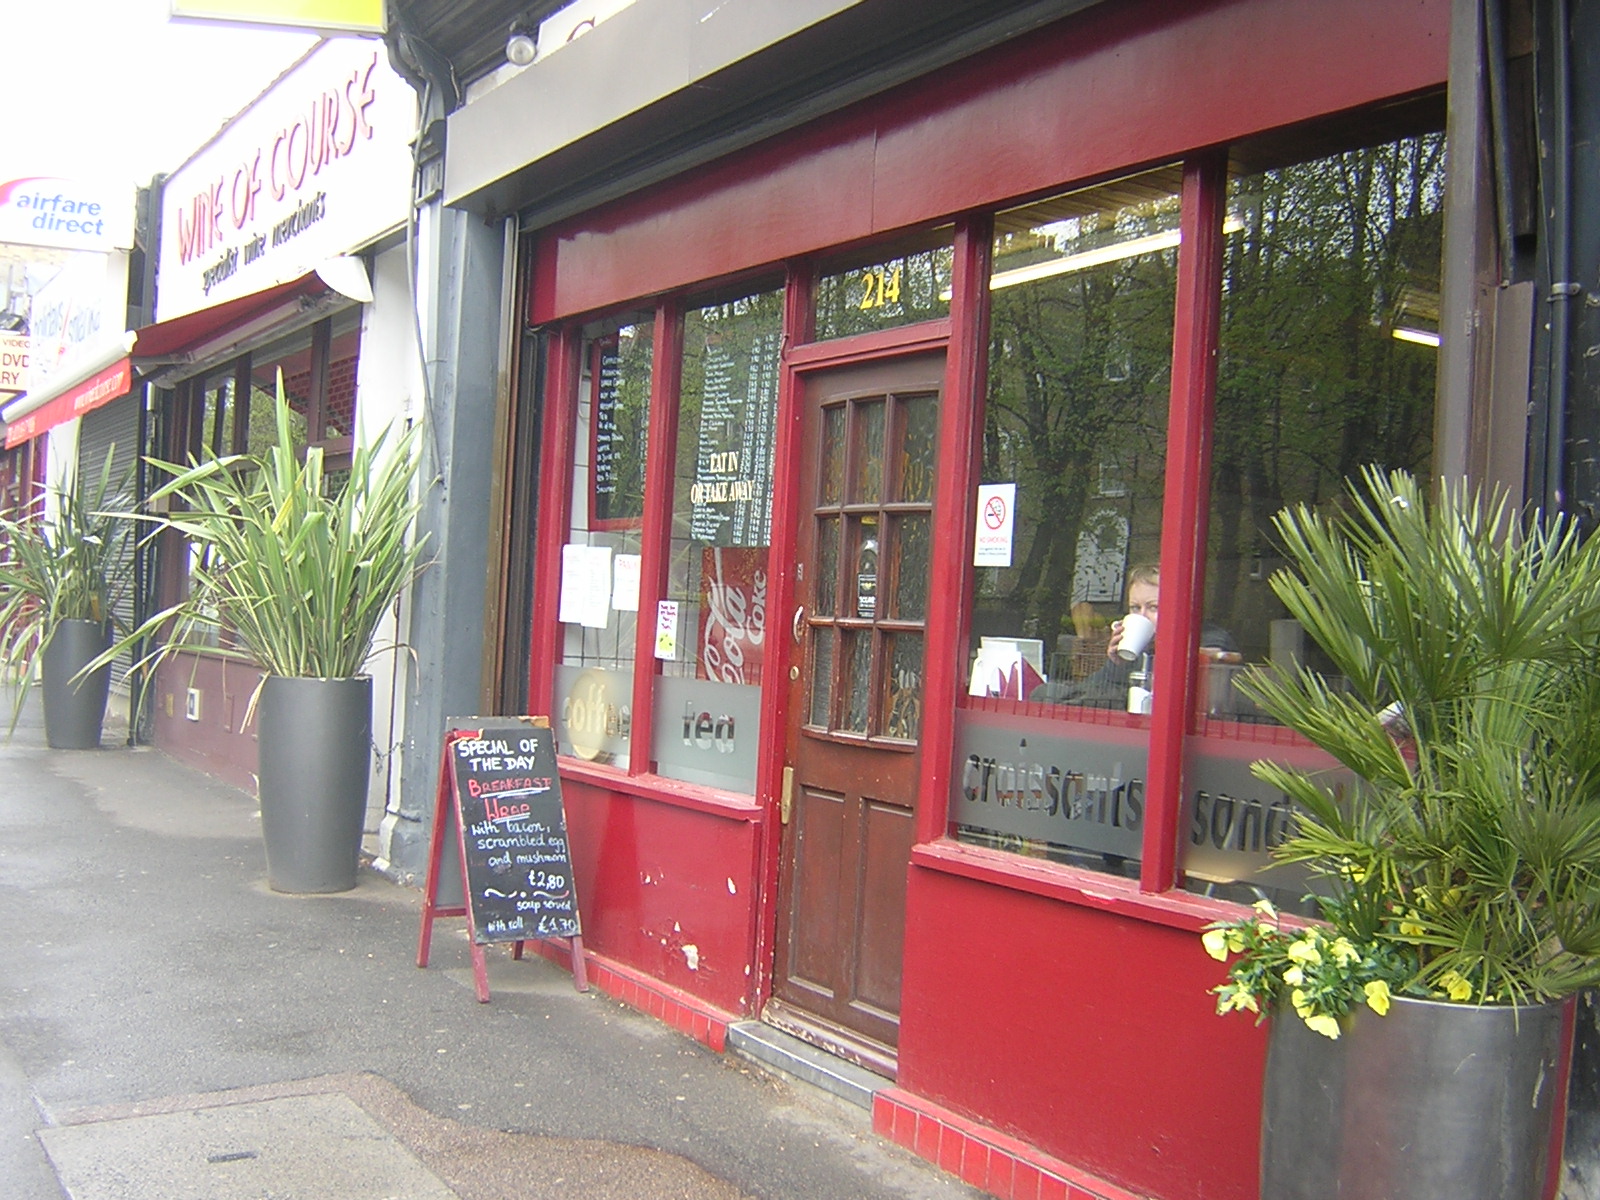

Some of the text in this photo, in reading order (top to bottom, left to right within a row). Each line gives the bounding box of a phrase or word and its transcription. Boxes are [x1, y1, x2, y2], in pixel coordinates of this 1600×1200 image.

[177, 51, 378, 266] WINE OF COURSE
[16, 192, 102, 216] airfare
[32, 212, 104, 236] direct
[202, 191, 326, 296] specialist wine merchants
[859, 269, 900, 310] 214
[0, 371, 20, 385] RY
[709, 452, 728, 473] EAT
[727, 451, 740, 472] IN
[690, 480, 755, 504] OR TAKE AWAY
[746, 569, 767, 646] Coke
[682, 703, 736, 754] tea
[457, 738, 539, 758] SPECIAL OF
[469, 756, 535, 772] THE DAY
[477, 834, 566, 853] scrambled egg
[488, 851, 567, 867] and mushroom
[516, 900, 571, 914] soup served
[487, 916, 524, 932] with roll
